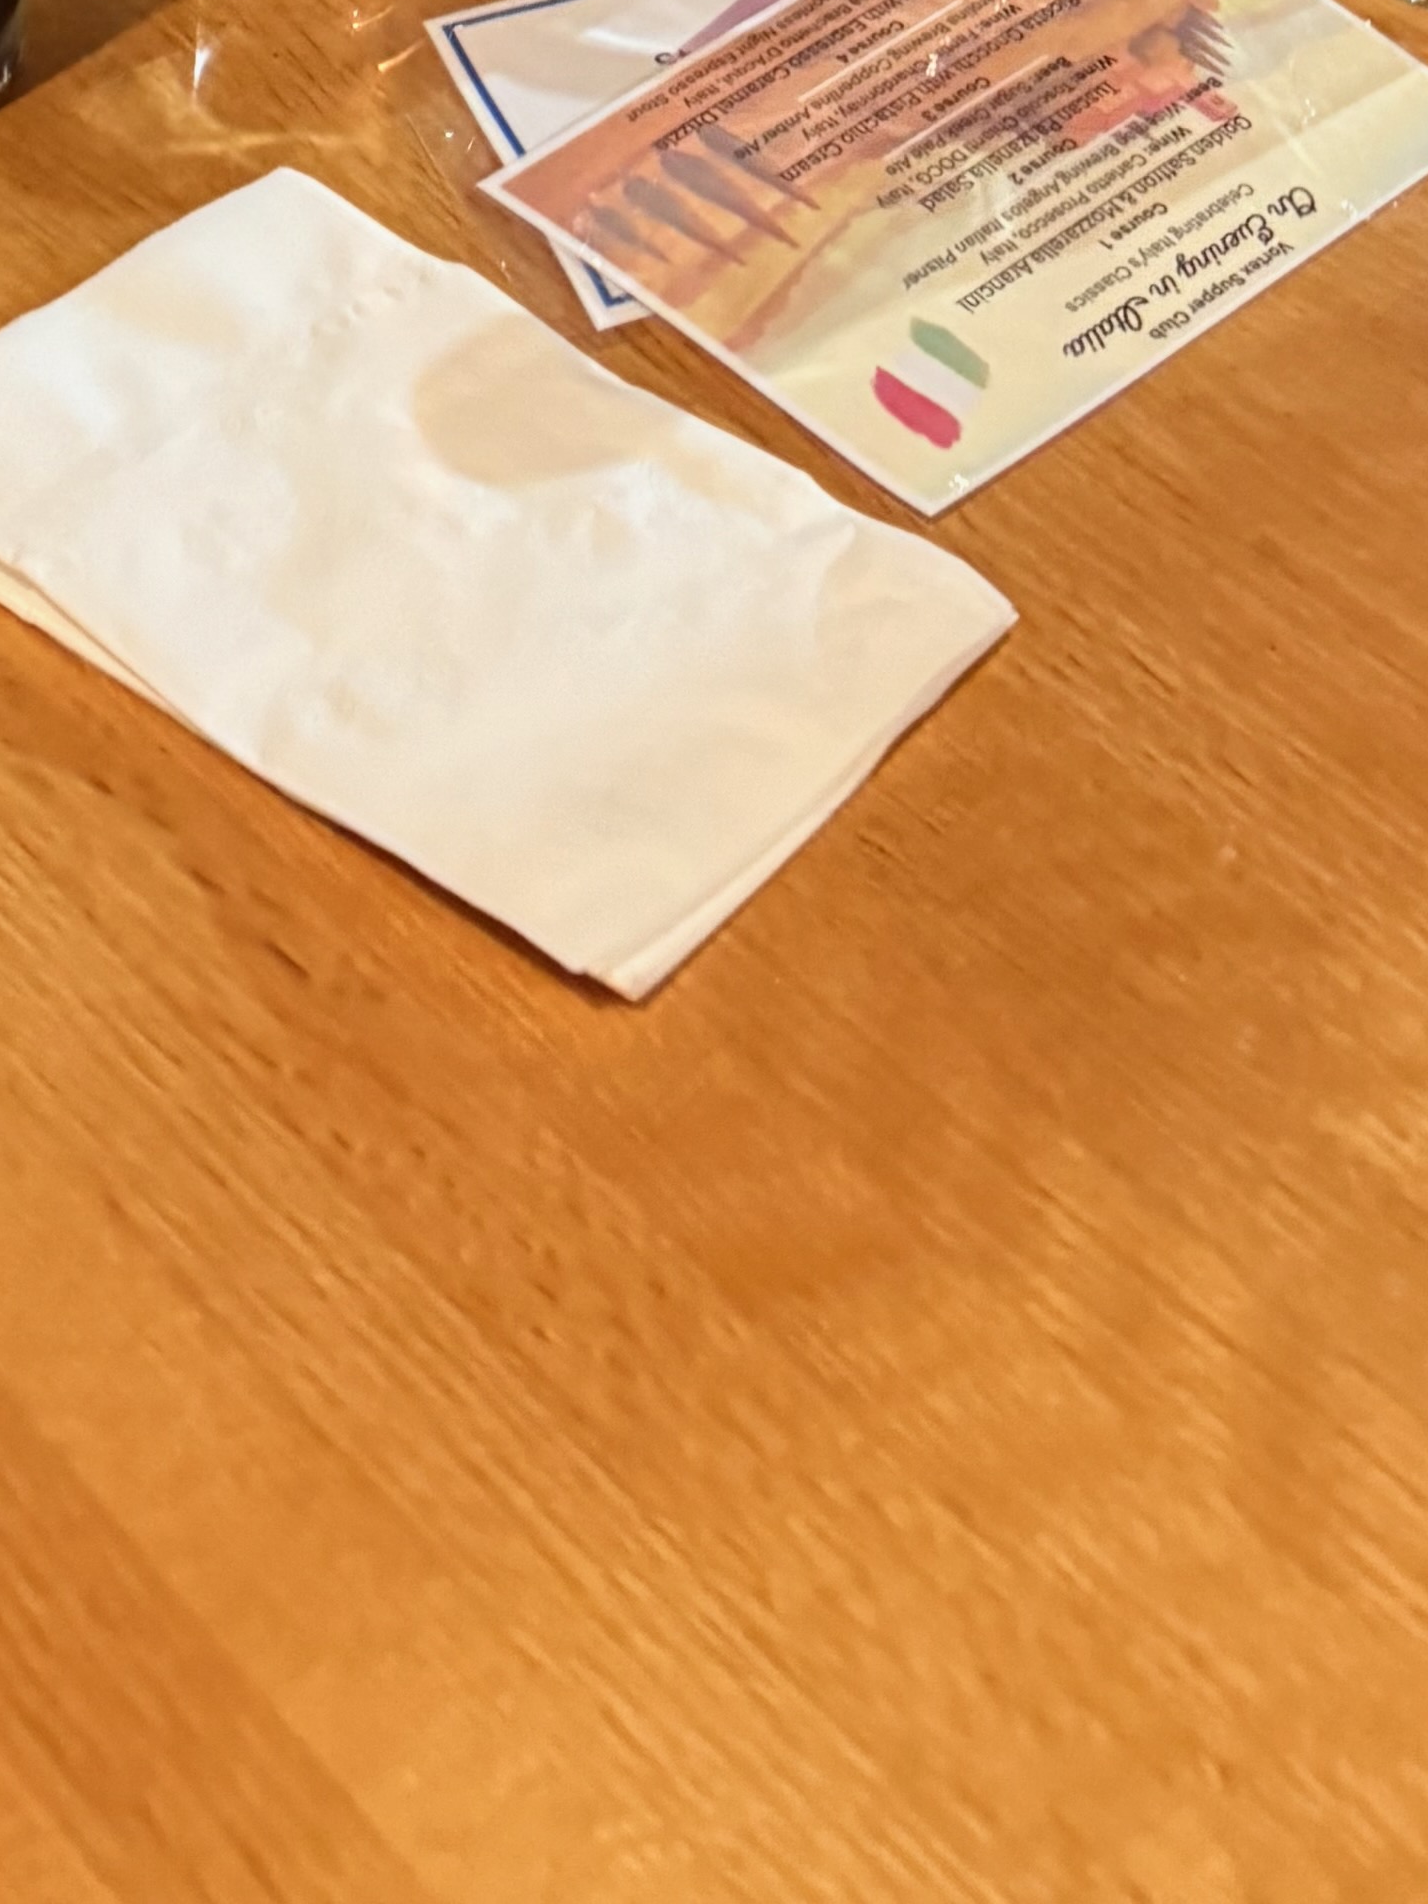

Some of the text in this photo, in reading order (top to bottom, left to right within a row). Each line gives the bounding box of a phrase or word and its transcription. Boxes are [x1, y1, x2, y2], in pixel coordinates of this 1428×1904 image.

[778, 4, 852, 47] Brachetto
[847, 20, 905, 54] Course
[974, 4, 1020, 31] Wine:
[732, 28, 777, 55] Night
[785, 19, 866, 67] Espresso
[884, 23, 949, 60] Brewing
[951, 28, 1026, 75] Gnocchi
[665, 52, 736, 93] Espresso
[809, 58, 893, 109] Copperline
[916, 70, 955, 97] with
[1070, 54, 1116, 82] Wine:
[621, 93, 668, 122] Stout
[679, 83, 720, 106] Italy
[712, 65, 791, 114] Caramel
[932, 76, 991, 112] Course
[1179, 77, 1222, 103] Beer:
[651, 110, 717, 149] Drizzle
[756, 107, 813, 141] Amber
[797, 116, 839, 139] Italy
[837, 93, 922, 143] Pistachio
[883, 57, 1071, 174] Beer: Sugar Creek Pale Ale
[961, 116, 1019, 153] Chianti
[1190, 115, 1252, 154] Golden
[730, 139, 761, 157] Ale
[779, 141, 844, 180] Cream
[917, 81, 1119, 211] Tuscan Panzanella Salad
[1019, 138, 1078, 174] Course
[1053, 144, 1119, 182] Brewing
[904, 150, 966, 184] DOCG,
[1132, 152, 1197, 192] Saffron
[872, 183, 915, 206] Italy
[974, 126, 1190, 263] Wine: Carletto Prosecco, Italy
[1000, 180, 1064, 220] Angelos
[953, 218, 1006, 251] Italian
[1028, 201, 1123, 261] Mozzarella
[1110, 202, 1169, 239] Course
[1063, 183, 1255, 310] Celebrating Italy's Classics
[897, 249, 958, 288] Pilsner
[956, 259, 1036, 312] Arancini
[1063, 186, 1317, 358] An Evening in Italia
[1148, 241, 1292, 340] Vortex Supper Club
